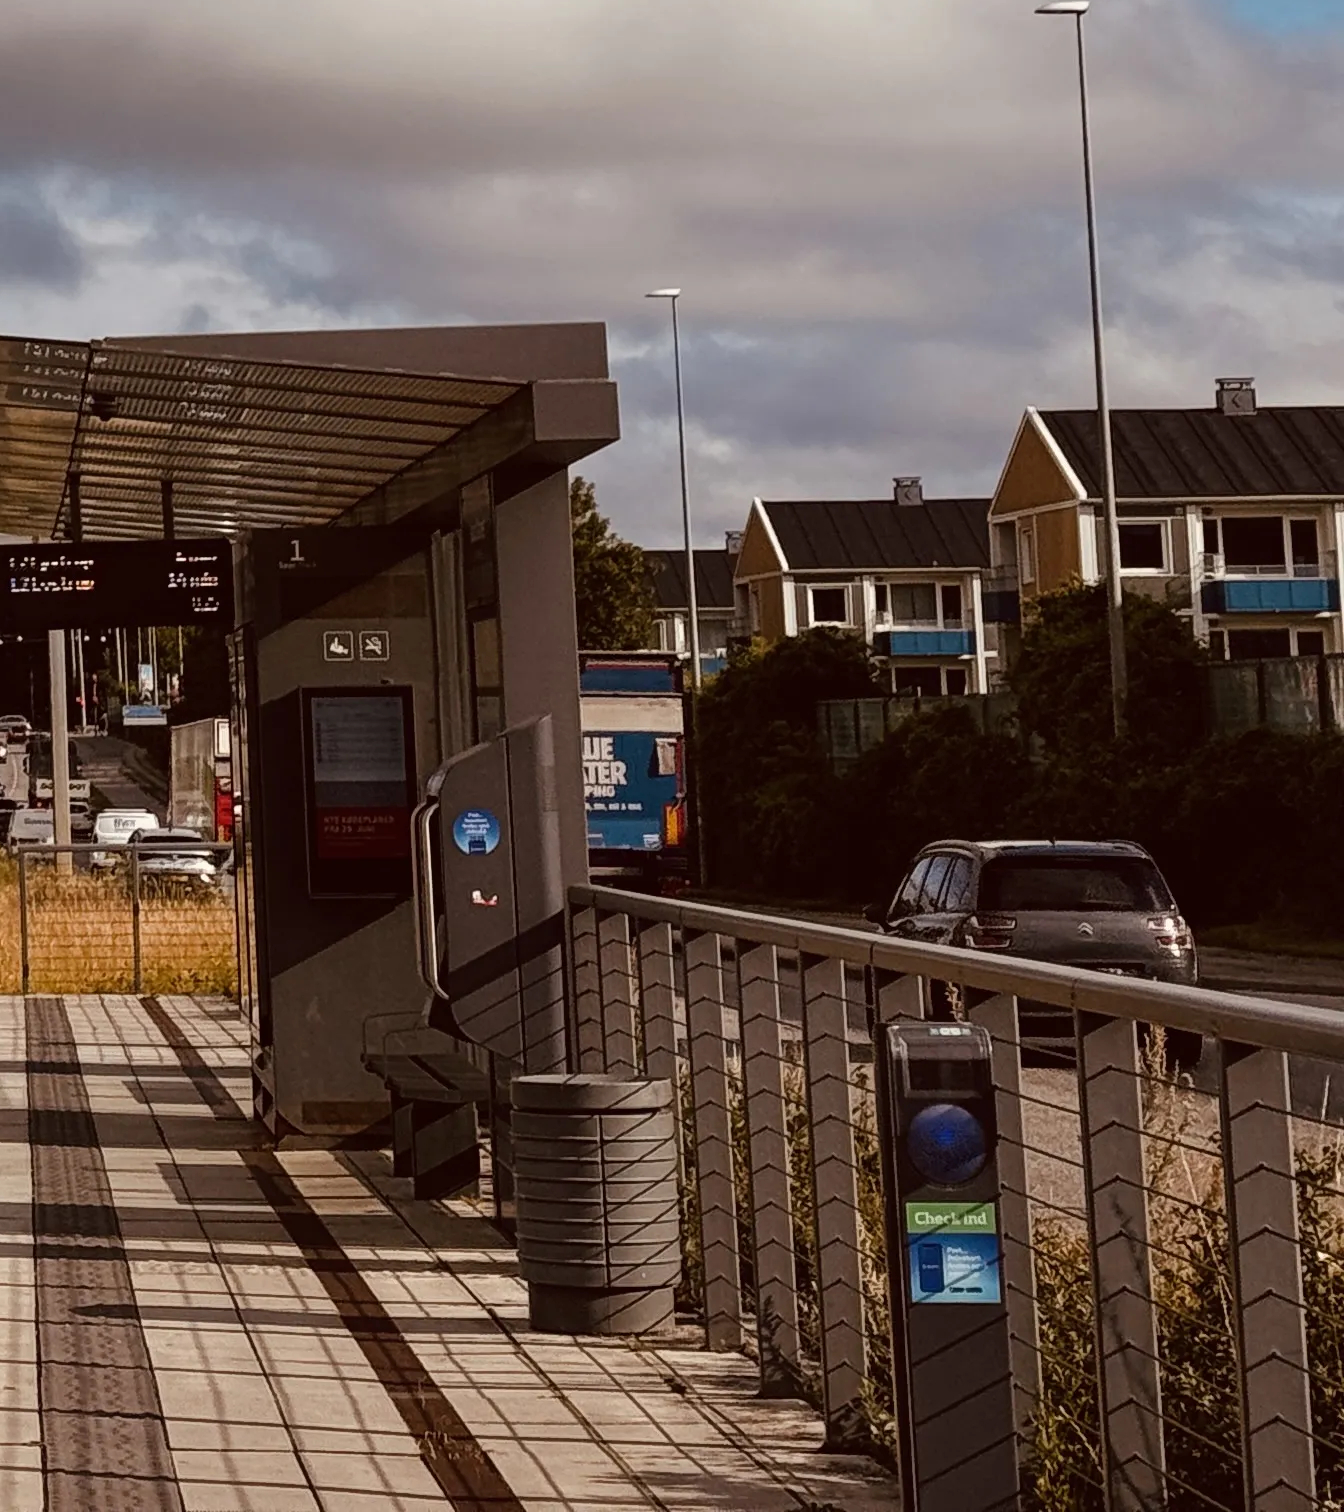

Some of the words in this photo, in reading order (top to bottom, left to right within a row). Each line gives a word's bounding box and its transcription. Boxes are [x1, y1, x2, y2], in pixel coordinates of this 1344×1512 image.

[290, 539, 305, 561] 1
[582, 737, 614, 761] UE
[914, 1211, 962, 1225] Check
[963, 1211, 988, 1225] ind
